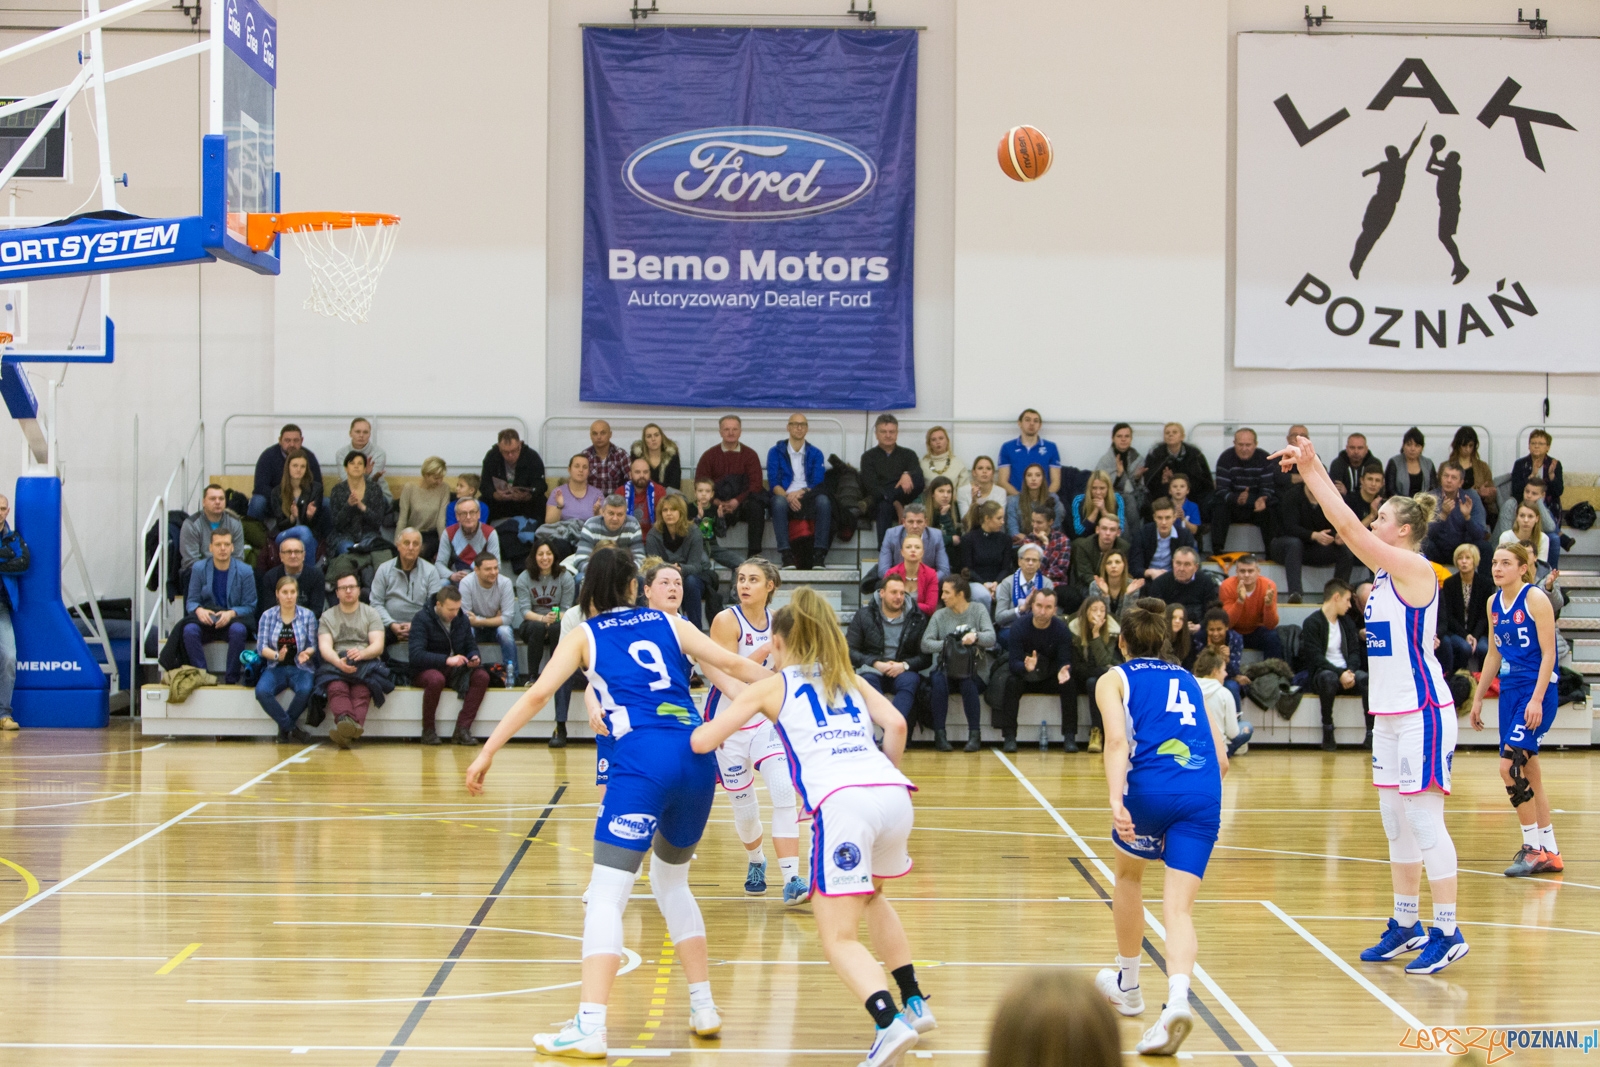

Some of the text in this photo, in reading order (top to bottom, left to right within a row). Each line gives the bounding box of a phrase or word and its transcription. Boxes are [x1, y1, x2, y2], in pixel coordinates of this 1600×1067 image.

[1273, 57, 1579, 174] LAK
[674, 140, 826, 203] Ford
[608, 249, 889, 281] Bemo Motors
[627, 290, 871, 309] Autoryzowany Dealer Ford
[1285, 272, 1539, 349] POZNAŃ
[1517, 627, 1530, 648] 5
[628, 640, 671, 692] 9
[795, 683, 862, 727] 14
[1166, 678, 1197, 726] 4
[1510, 724, 1526, 742] 5
